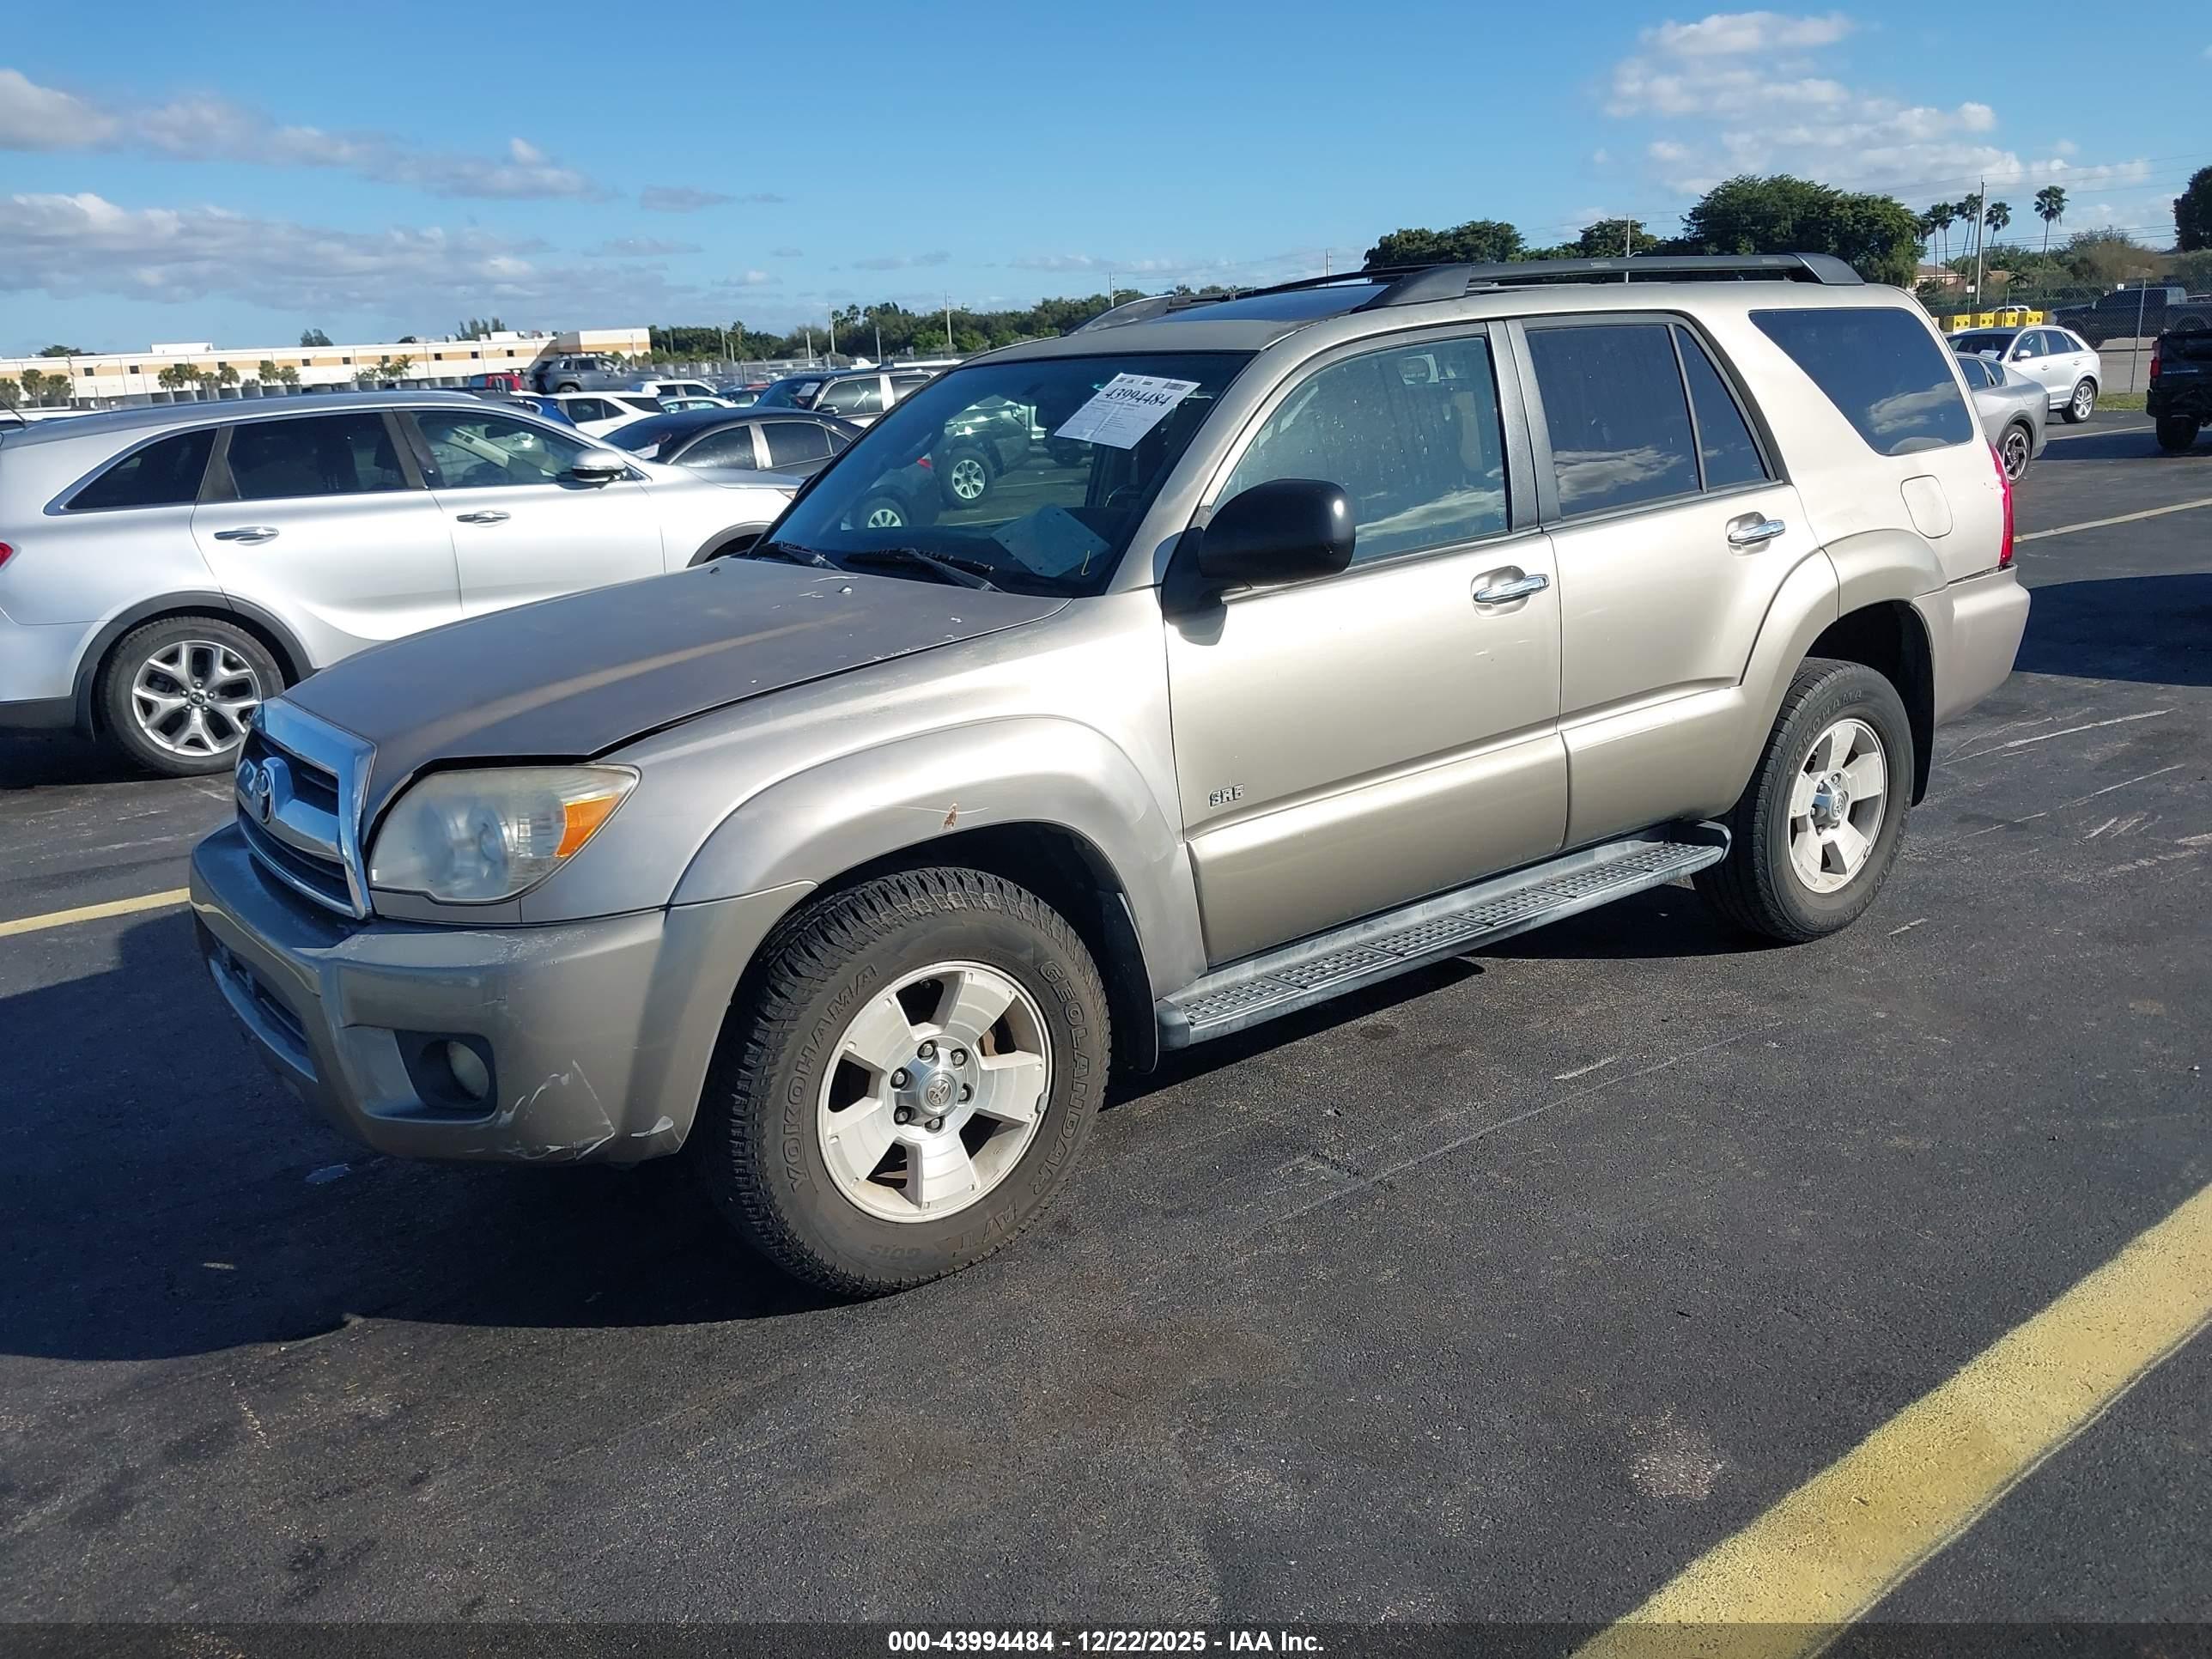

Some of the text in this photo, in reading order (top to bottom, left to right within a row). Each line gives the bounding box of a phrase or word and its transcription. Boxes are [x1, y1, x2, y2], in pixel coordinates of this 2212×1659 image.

[1105, 388, 1174, 407] 43994484
[1787, 689, 1863, 776] YOKOHAMA
[782, 963, 878, 1195] YOKOHAMA
[1030, 961, 1090, 1195] GEOLANDAR
